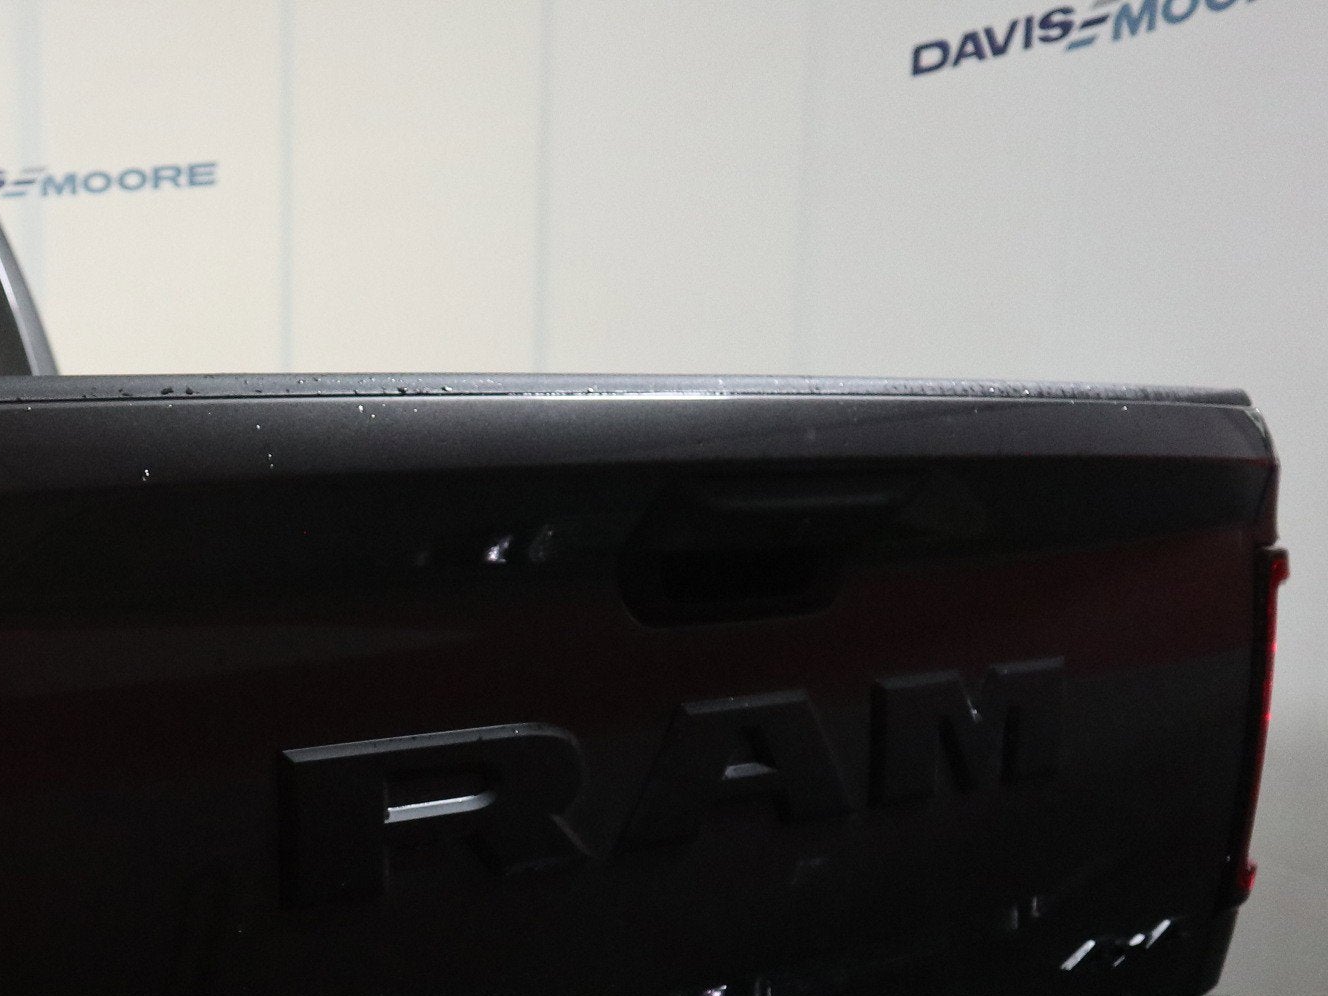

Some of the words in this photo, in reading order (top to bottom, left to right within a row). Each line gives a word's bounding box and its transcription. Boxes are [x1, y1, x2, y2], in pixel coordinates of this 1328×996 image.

[910, 6, 1075, 76] DAVIS
[40, 162, 219, 197] MOORE
[278, 656, 1066, 908] RAM
